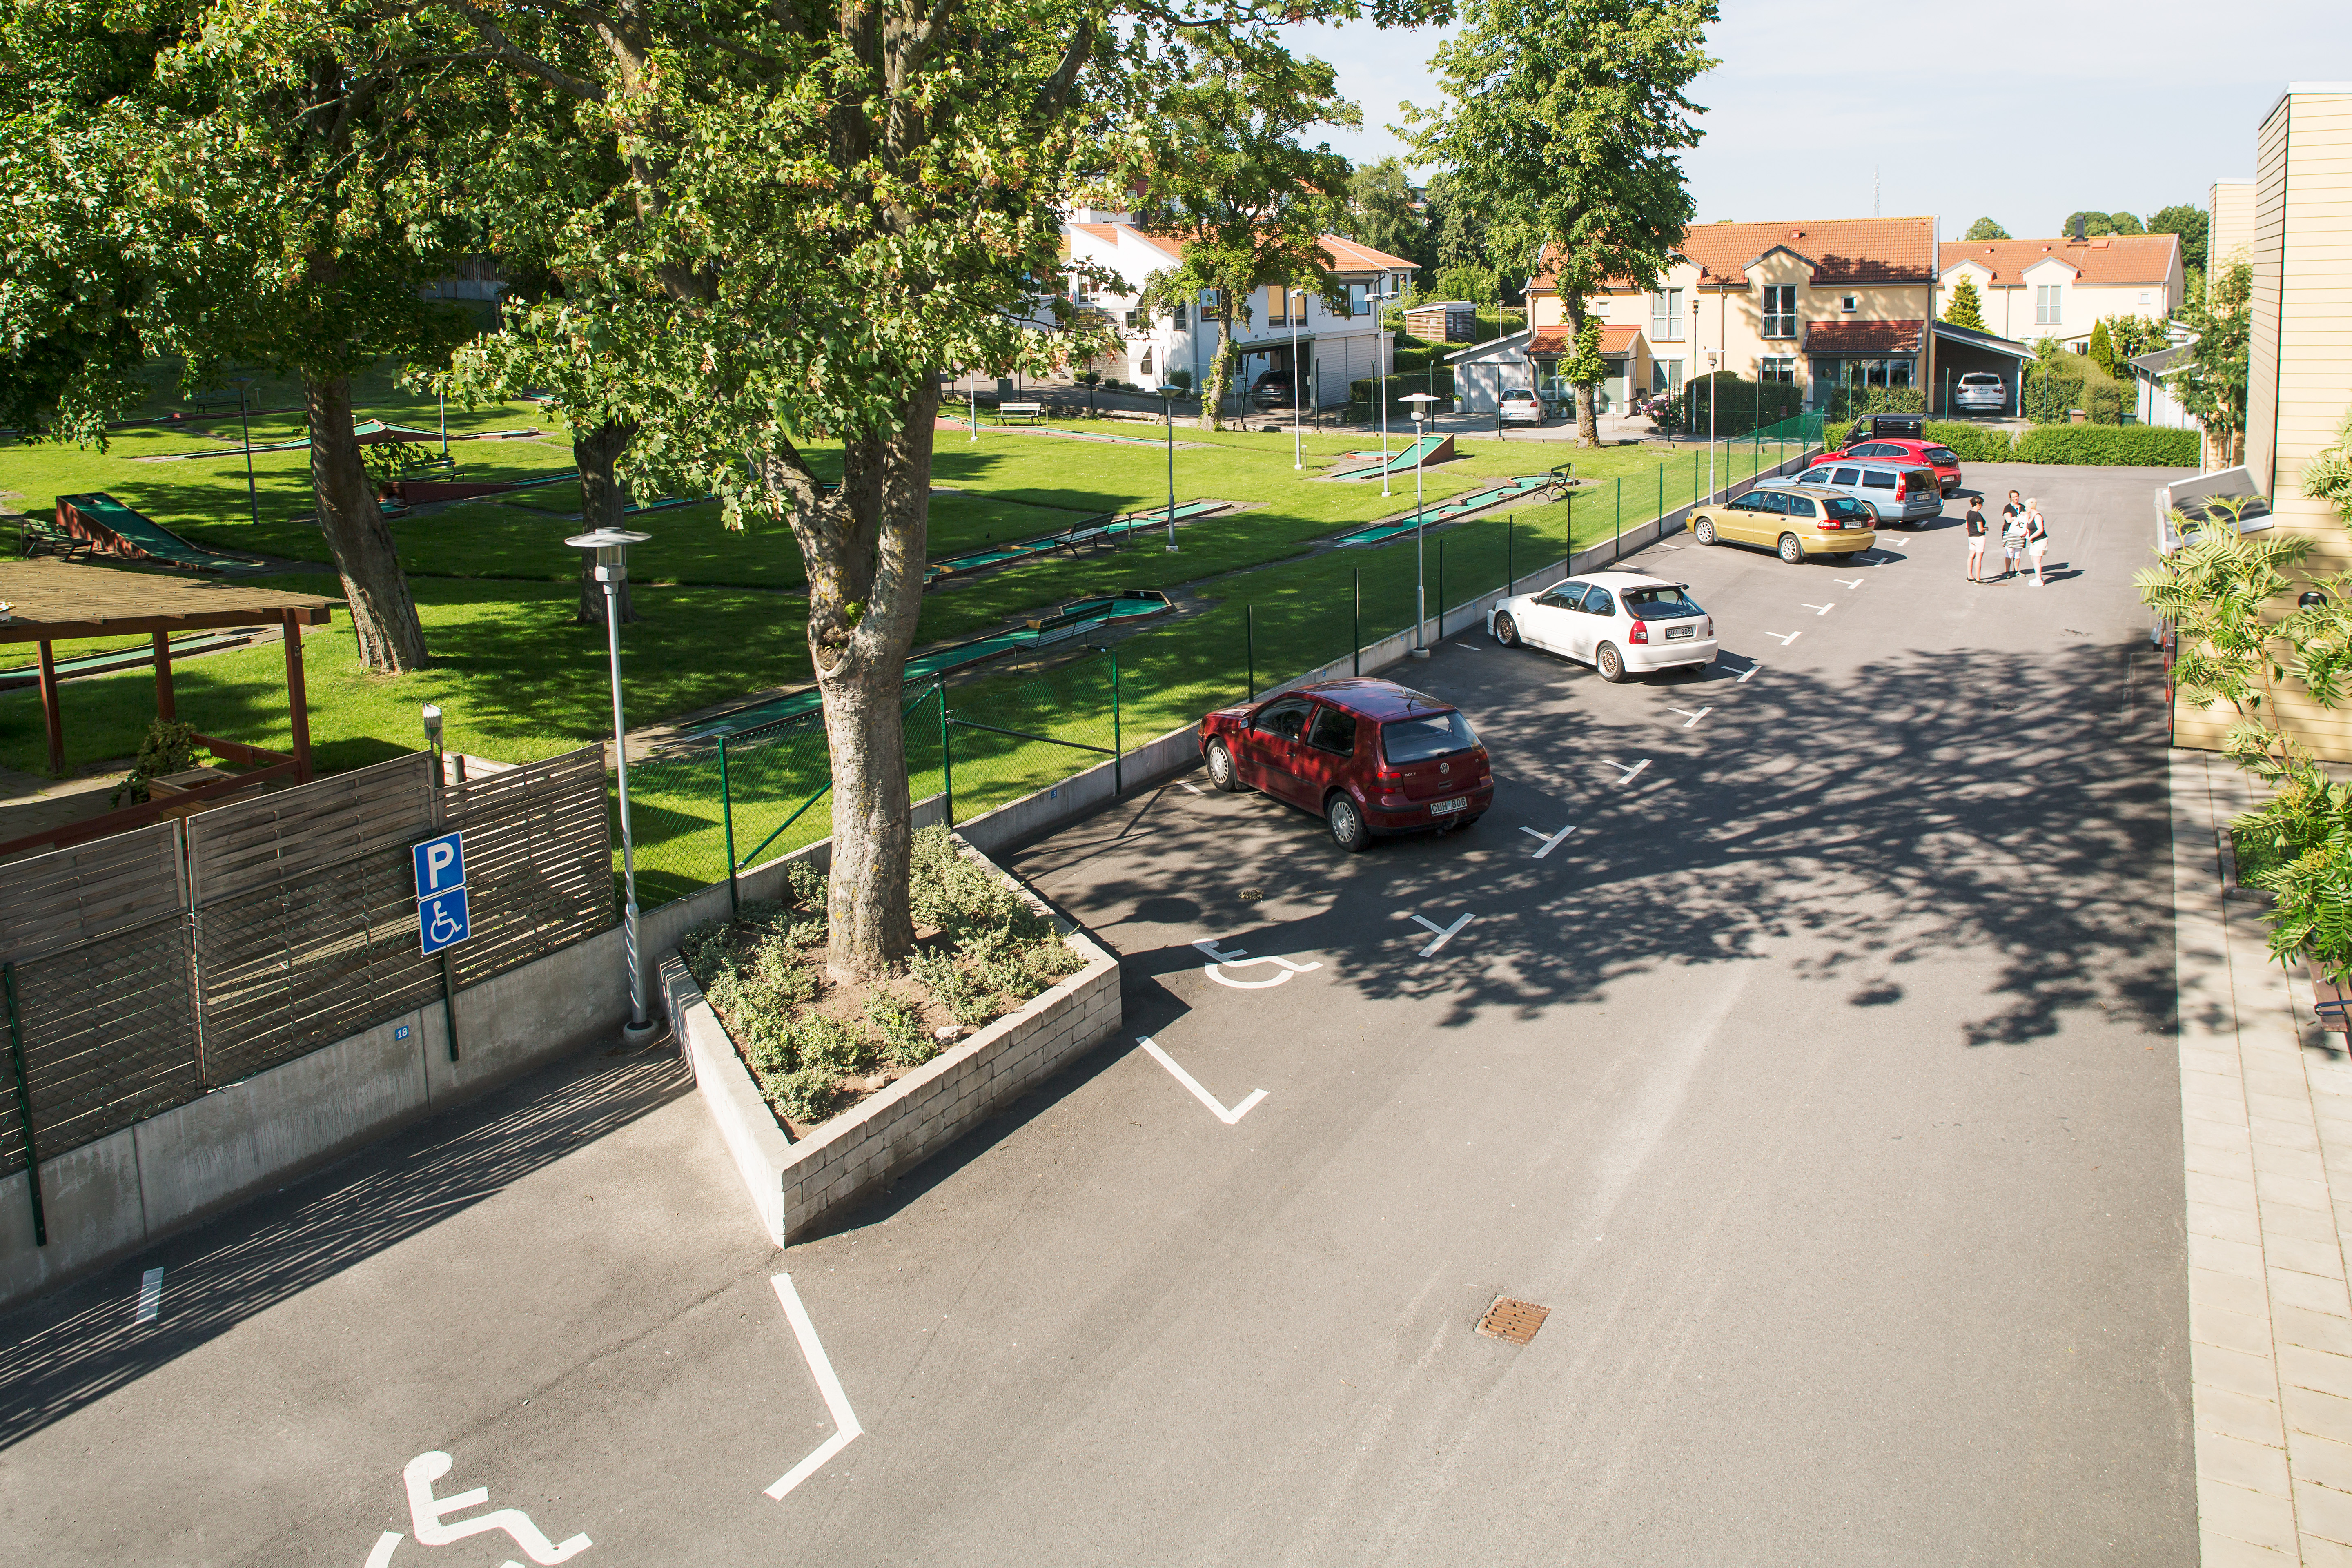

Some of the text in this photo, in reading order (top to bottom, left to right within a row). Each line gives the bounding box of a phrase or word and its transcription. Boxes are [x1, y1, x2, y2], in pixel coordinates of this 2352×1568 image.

[1432, 802, 1447, 813] CUH
[1452, 797, 1466, 808] 806
[427, 842, 454, 889] P
[398, 1027, 408, 1038] 18
